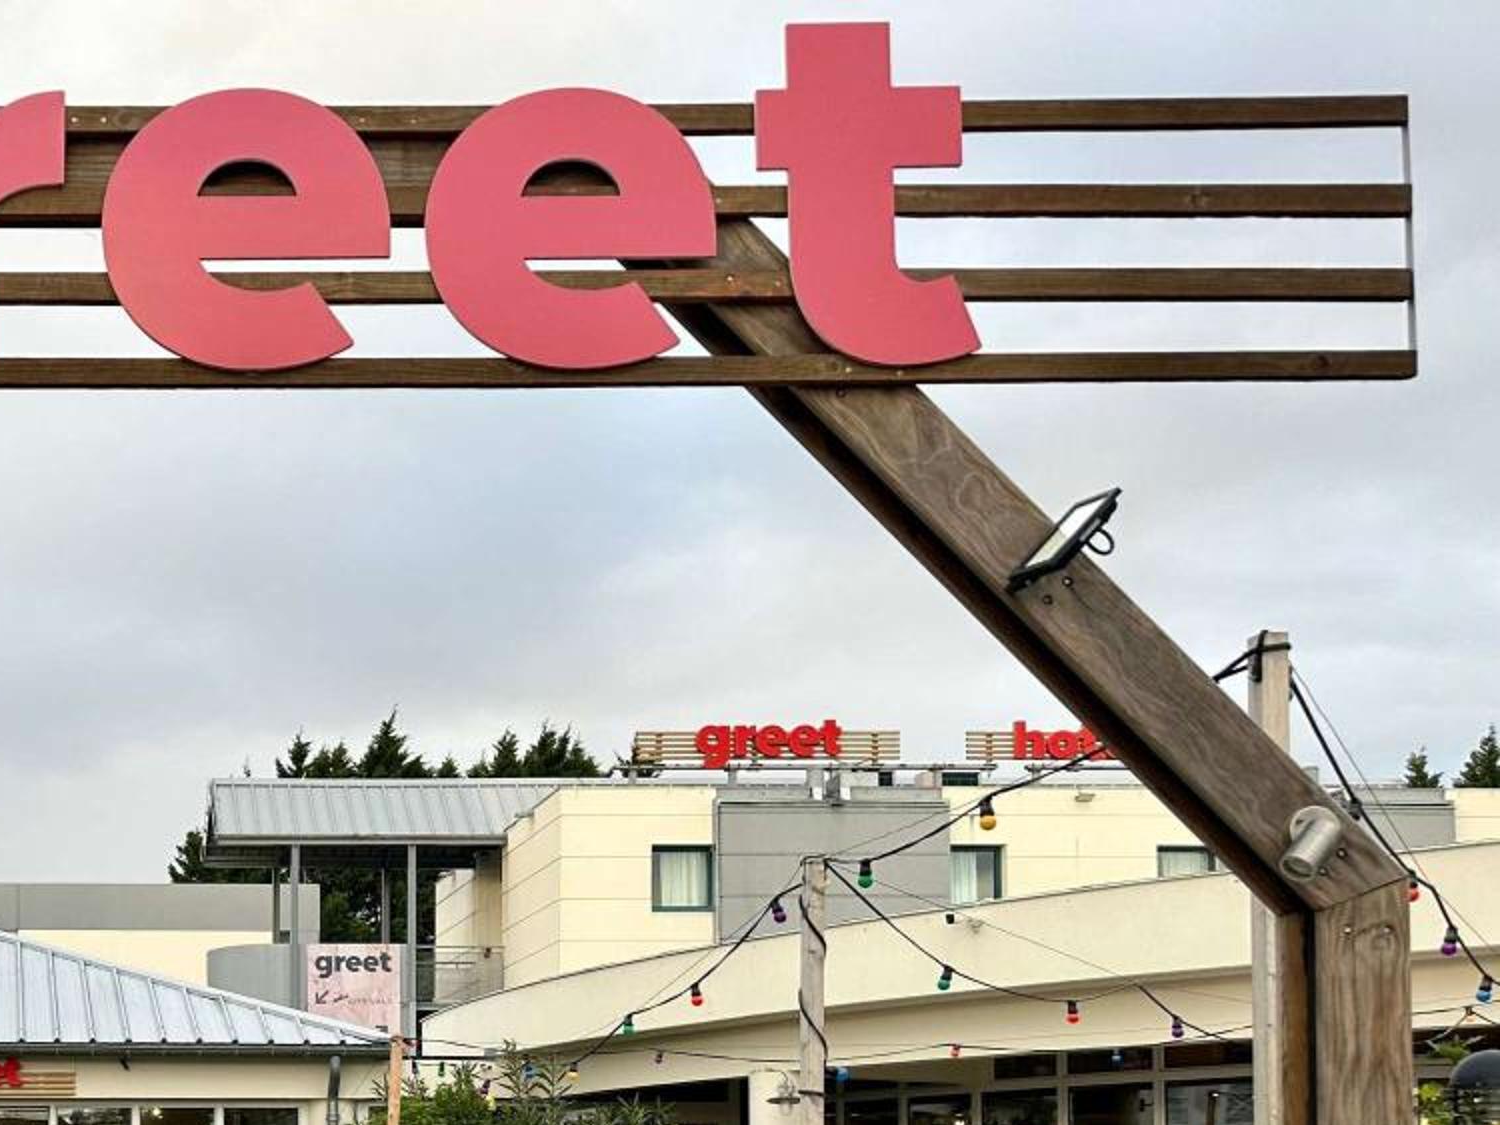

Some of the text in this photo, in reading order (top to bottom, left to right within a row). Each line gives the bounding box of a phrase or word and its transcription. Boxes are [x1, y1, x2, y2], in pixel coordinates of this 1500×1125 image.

[695, 719, 1117, 769] greet hot
[315, 952, 392, 978] greet
